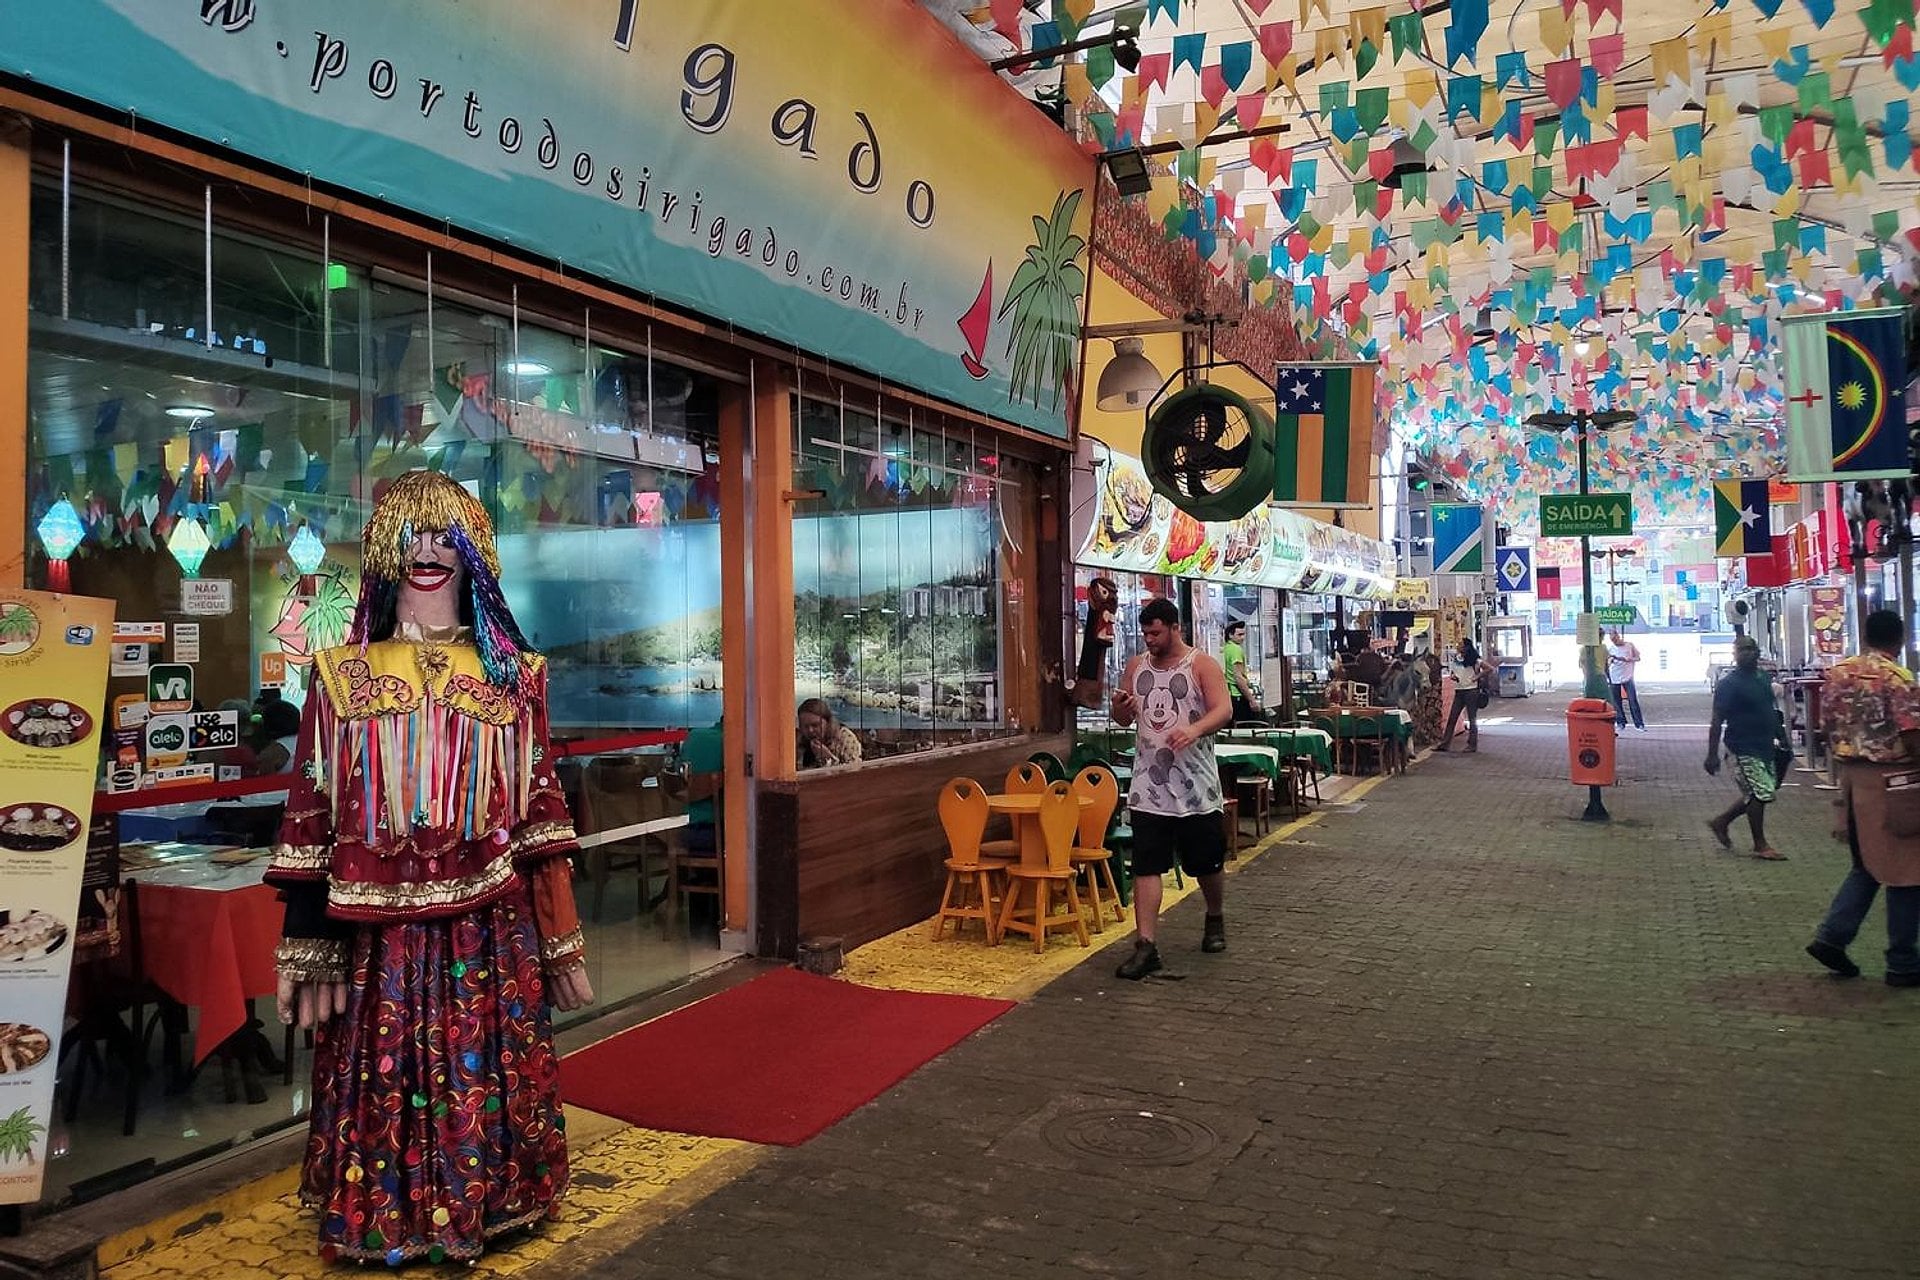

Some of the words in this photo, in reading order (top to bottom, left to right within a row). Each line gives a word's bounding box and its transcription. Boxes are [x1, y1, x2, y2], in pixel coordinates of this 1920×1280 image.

[1546, 502, 1607, 521] SAÍDA
[1597, 608, 1623, 620] SAÍDA
[265, 659, 283, 676] Up
[194, 713, 221, 726] use
[152, 730, 181, 745] alelo
[210, 728, 234, 743] elo
